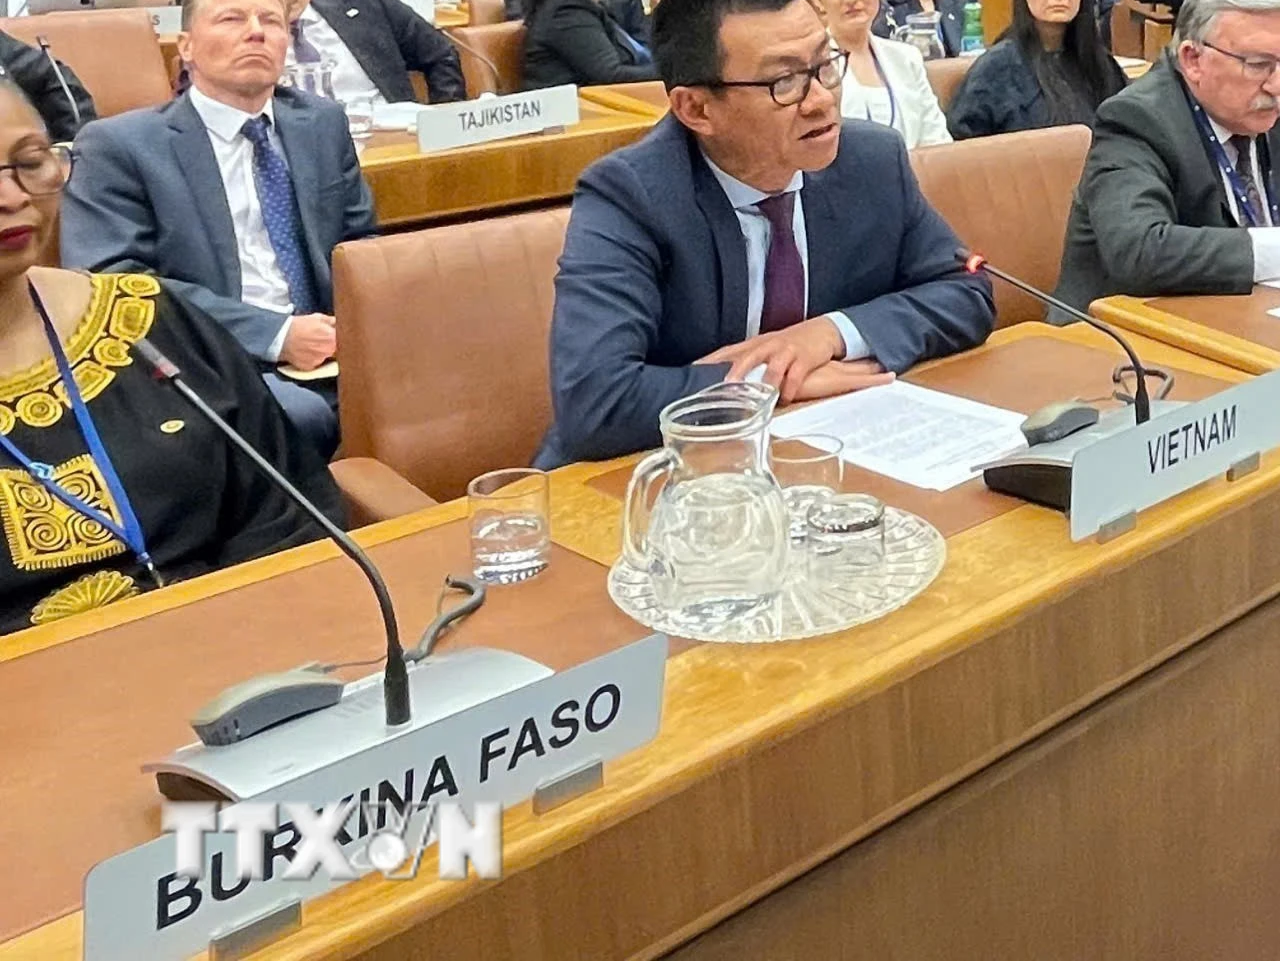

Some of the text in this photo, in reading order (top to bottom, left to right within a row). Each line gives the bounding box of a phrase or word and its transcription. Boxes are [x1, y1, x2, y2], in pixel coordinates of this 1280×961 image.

[458, 100, 541, 131] TAJIKISTAN
[1147, 404, 1238, 474] VIETNAM
[478, 683, 622, 784] FASO
